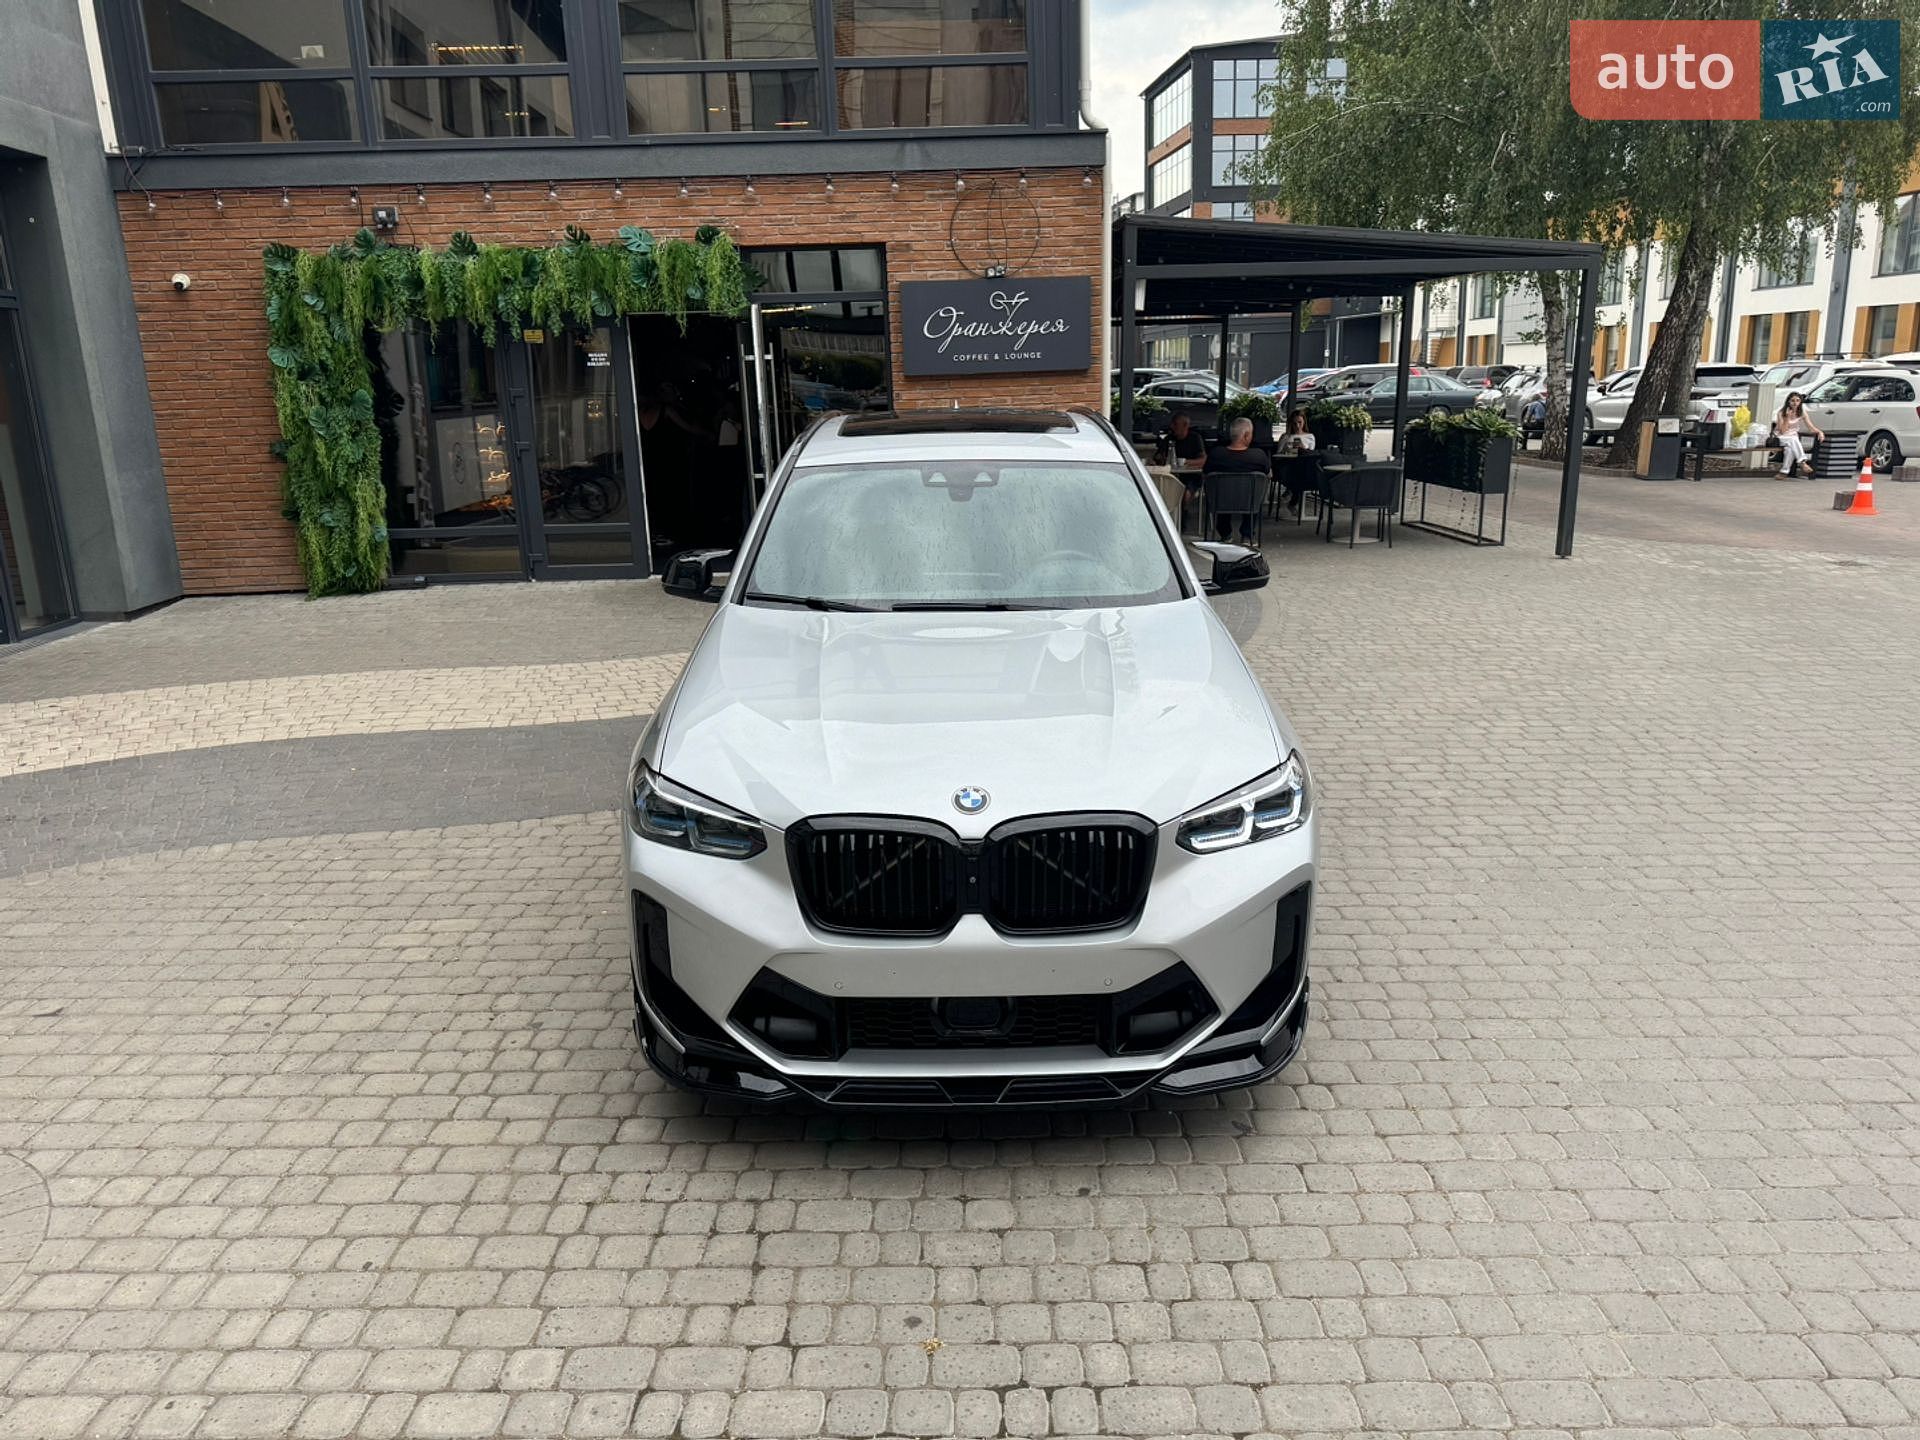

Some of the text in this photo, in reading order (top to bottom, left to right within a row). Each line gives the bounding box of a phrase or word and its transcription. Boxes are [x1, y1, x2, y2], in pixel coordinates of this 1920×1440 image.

[923, 306, 1071, 354] Оранжерея
[953, 351, 1042, 362] COFFEE & LOUNGE
